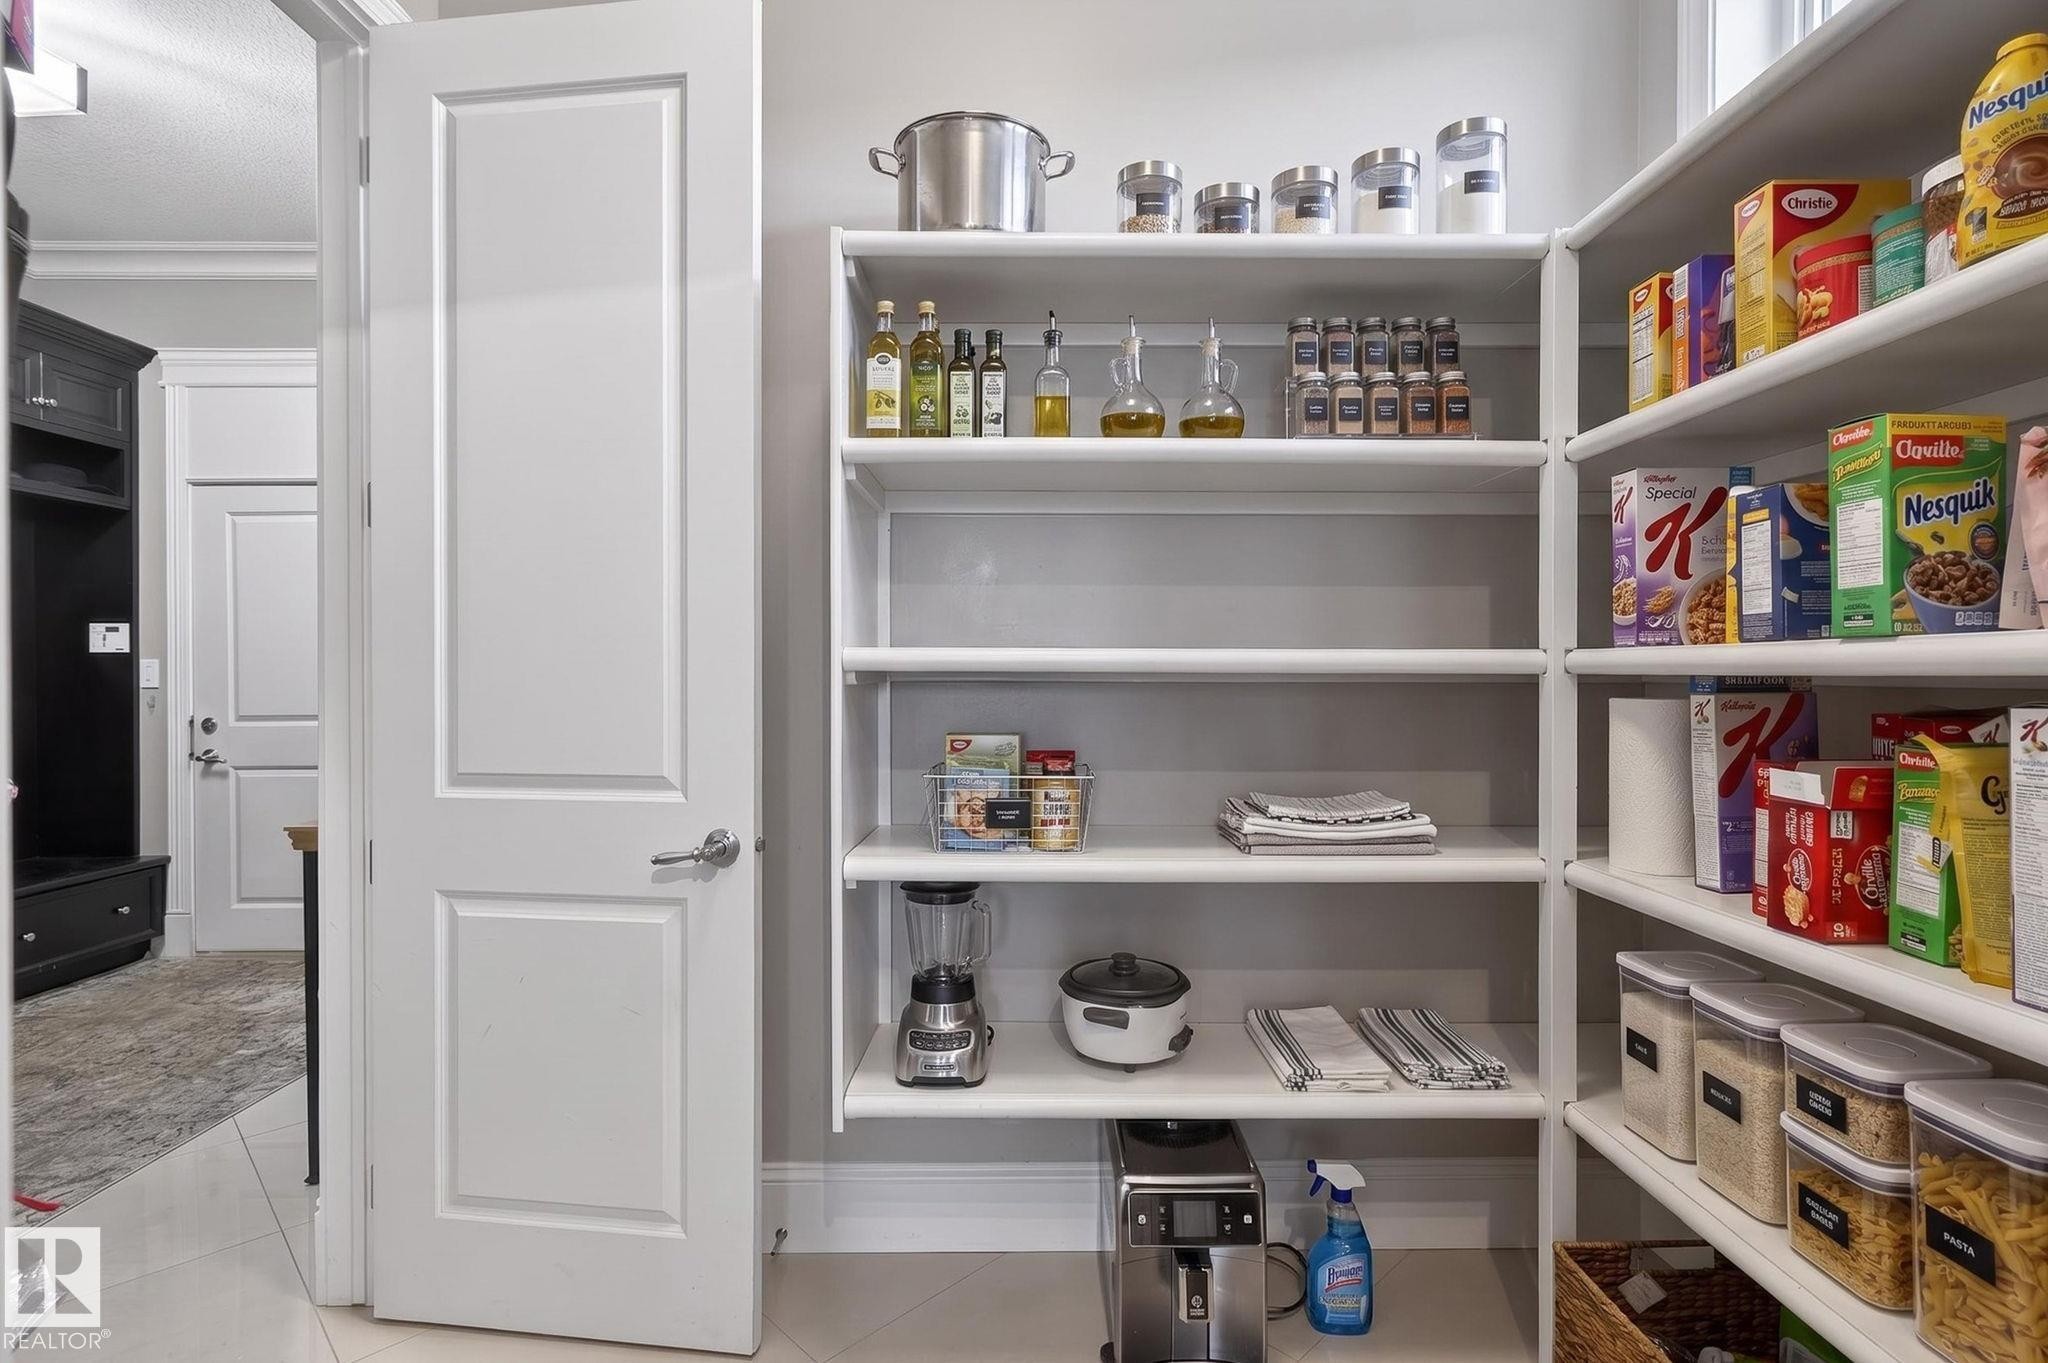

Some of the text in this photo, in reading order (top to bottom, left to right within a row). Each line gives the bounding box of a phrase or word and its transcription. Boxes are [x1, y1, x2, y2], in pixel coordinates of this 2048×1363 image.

[1787, 197, 1833, 209] Christie
[1645, 486, 1697, 502] Special
[1904, 477, 1995, 527] Nesquik
[1644, 486, 1729, 580] K
[1943, 1231, 1976, 1258] PASTA
